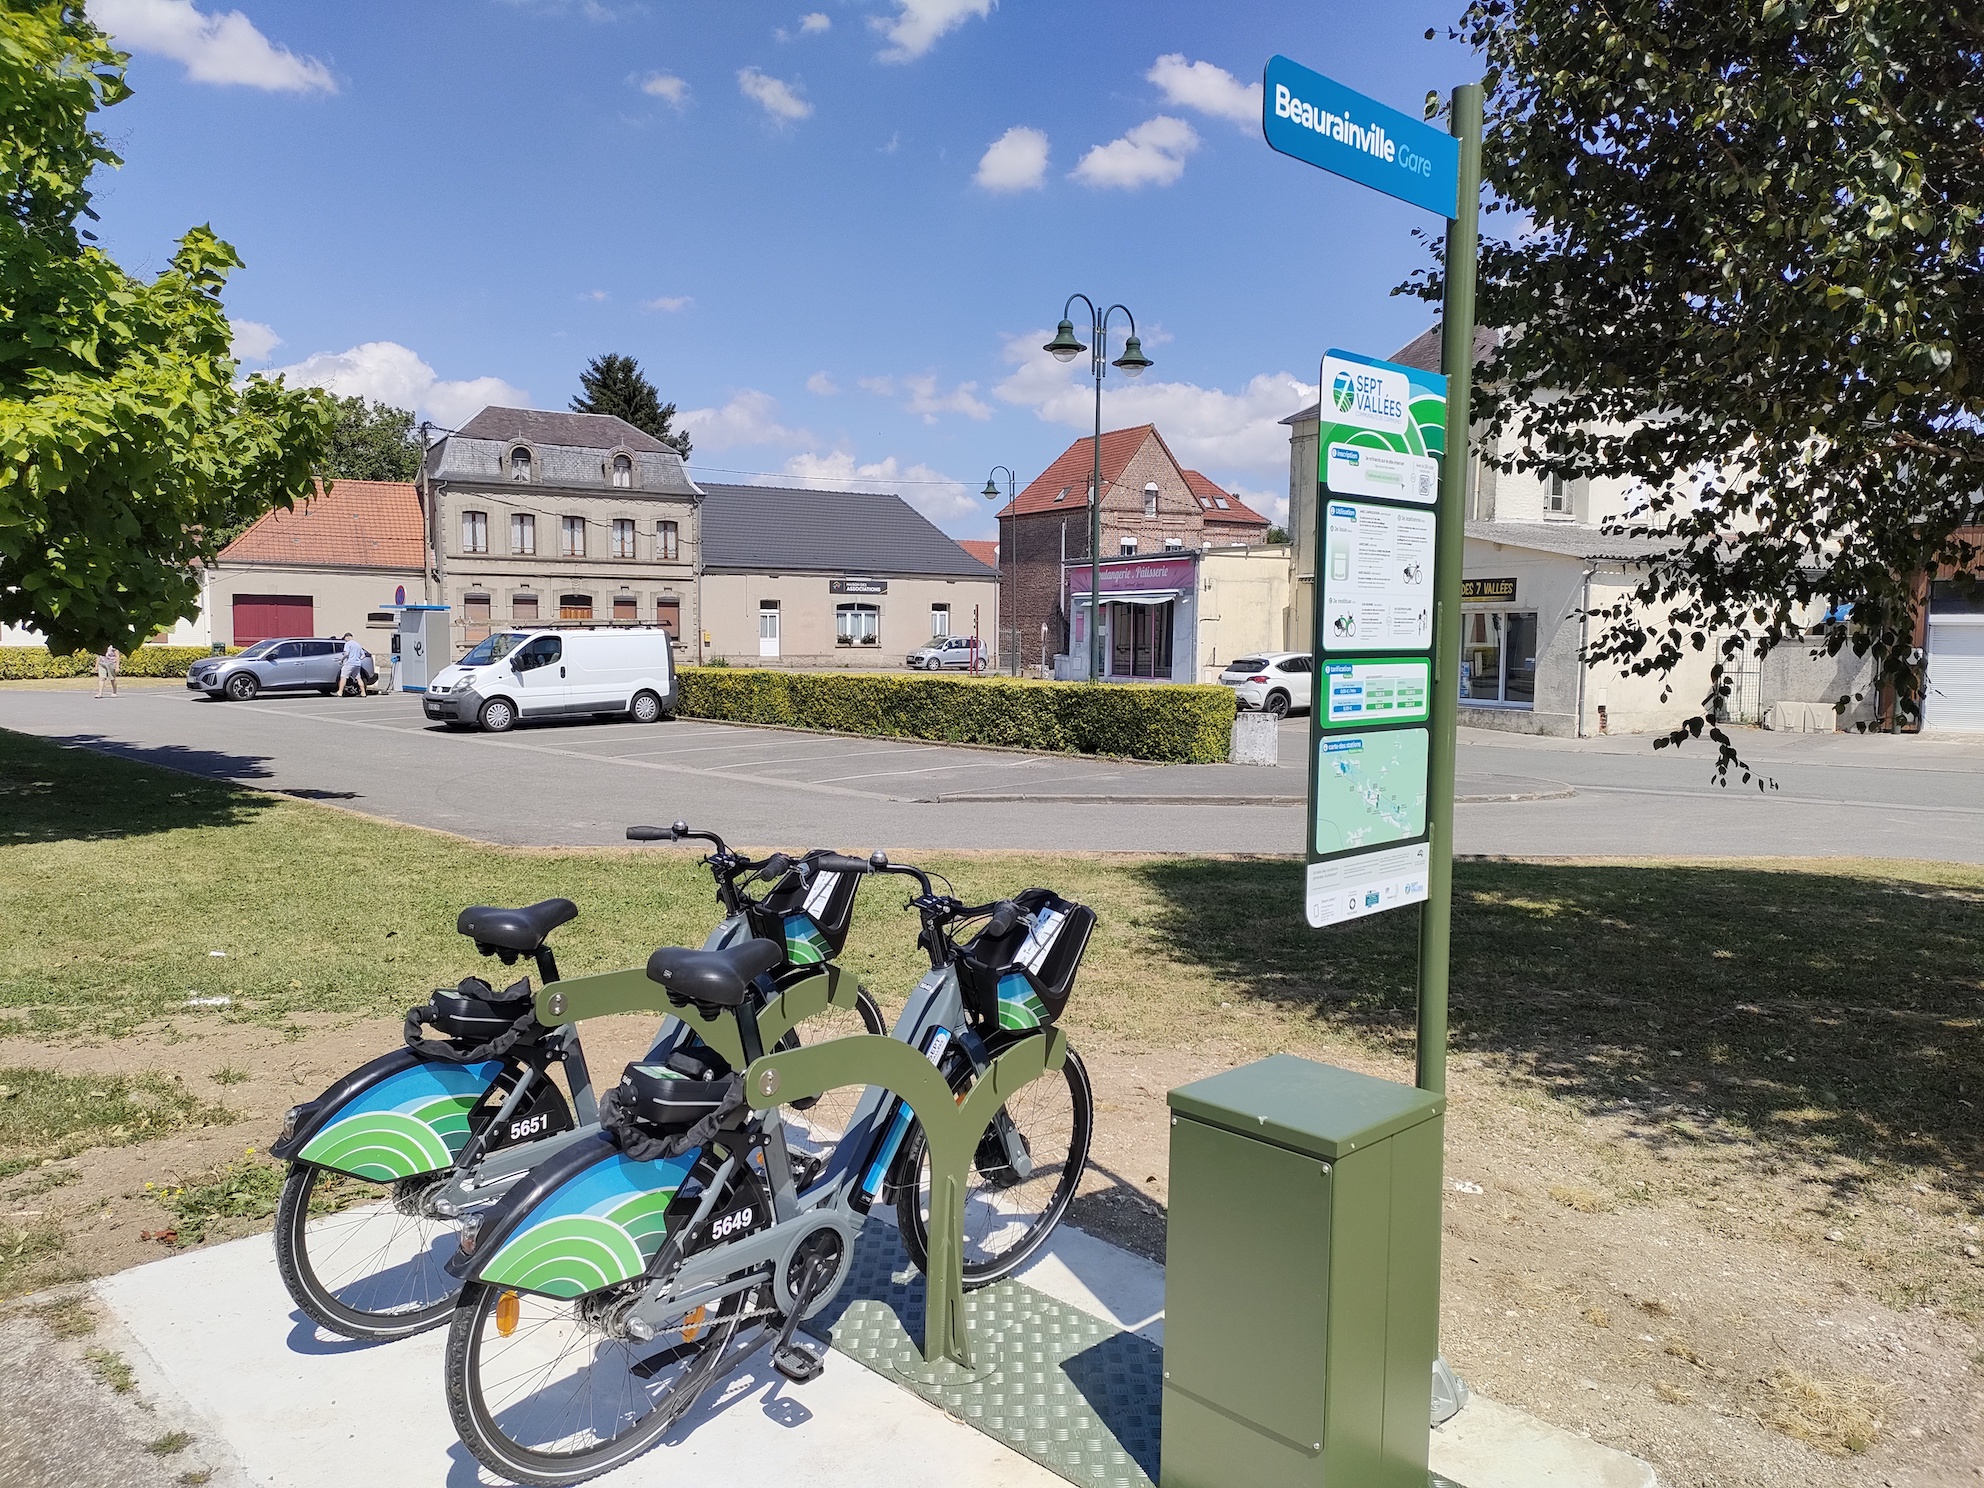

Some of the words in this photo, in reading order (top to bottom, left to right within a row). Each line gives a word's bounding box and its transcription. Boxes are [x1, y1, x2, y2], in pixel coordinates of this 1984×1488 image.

[1275, 83, 1395, 162] Beaurainville
[1398, 143, 1432, 177] Gare
[1357, 375, 1383, 396] SEPT
[1357, 393, 1402, 418] VALLÉES
[1099, 569, 1131, 583] oulangerie
[1462, 582, 1474, 596] DES
[1476, 582, 1481, 595] 7
[1484, 580, 1513, 595] VALLÉES
[511, 1113, 547, 1140] 5651
[712, 1207, 753, 1240] 5649
